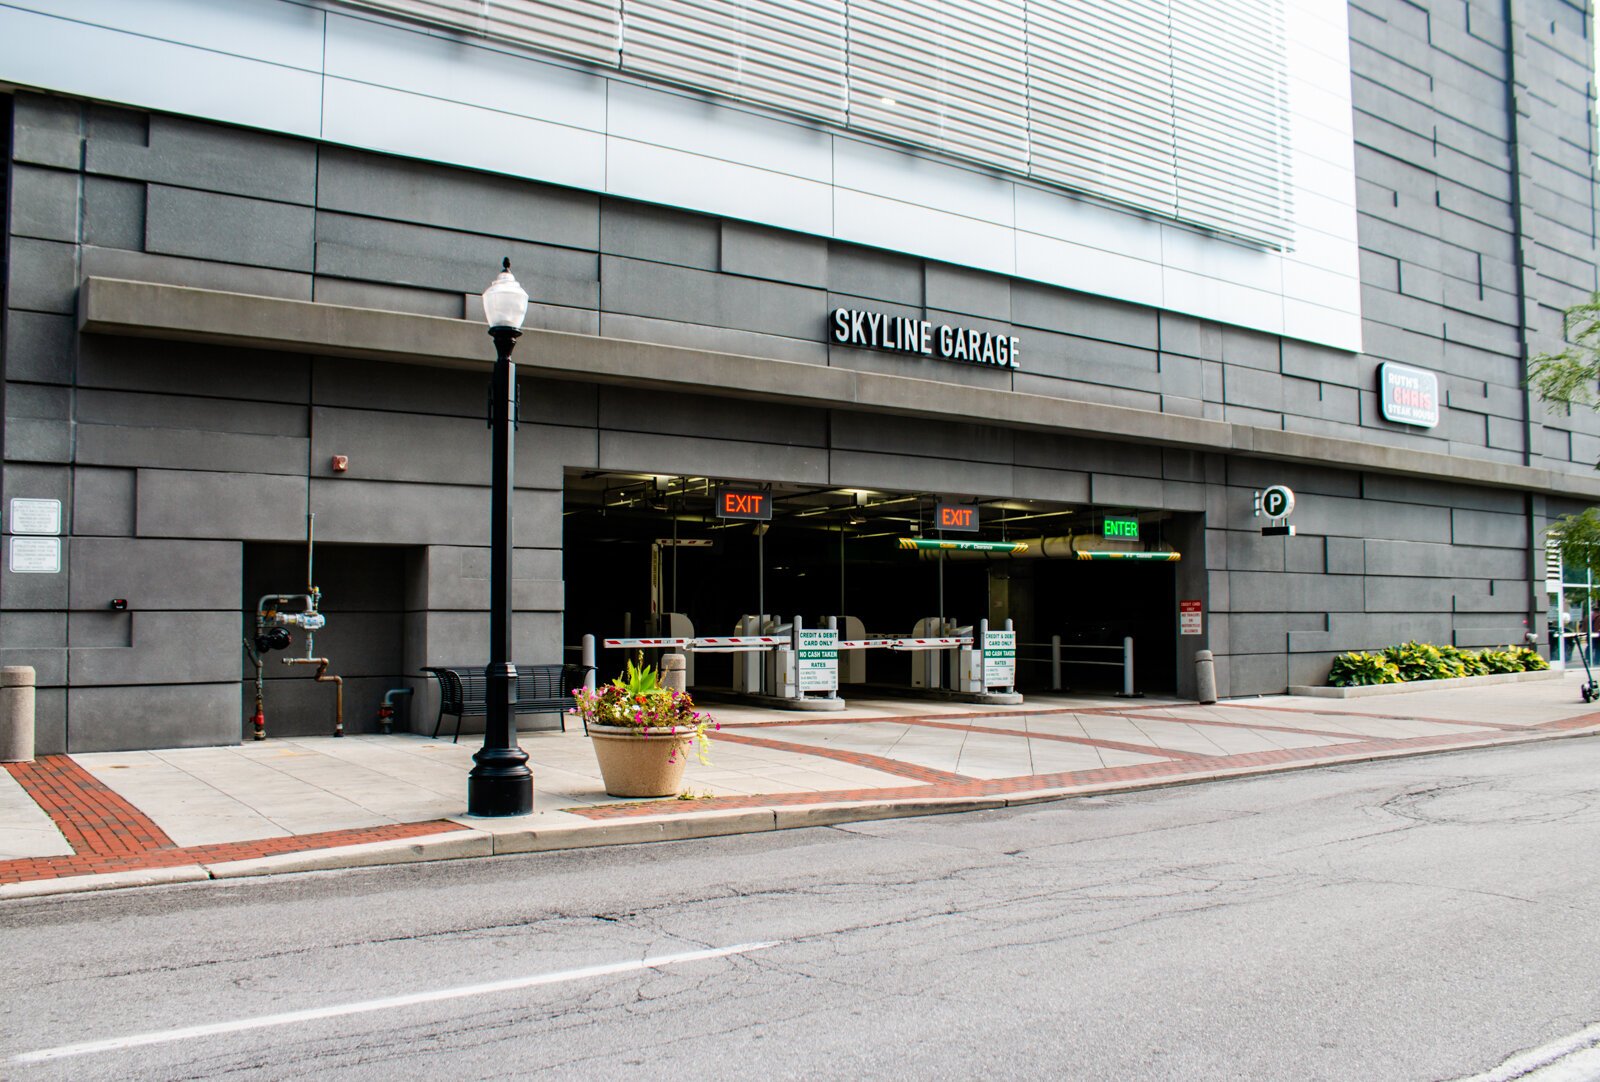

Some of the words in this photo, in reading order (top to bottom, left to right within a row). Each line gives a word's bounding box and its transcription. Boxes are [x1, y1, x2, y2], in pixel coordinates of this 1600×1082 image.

[835, 307, 933, 354] SKYLINE
[940, 324, 1020, 368] GARAGE
[1388, 372, 1418, 389] RUTH'S
[1393, 386, 1432, 410] CHRIS
[1387, 403, 1412, 416] STEAK
[726, 494, 763, 513] EXIT
[1270, 493, 1282, 513] P
[942, 508, 973, 526] EXIT
[1104, 520, 1138, 537] ENTER
